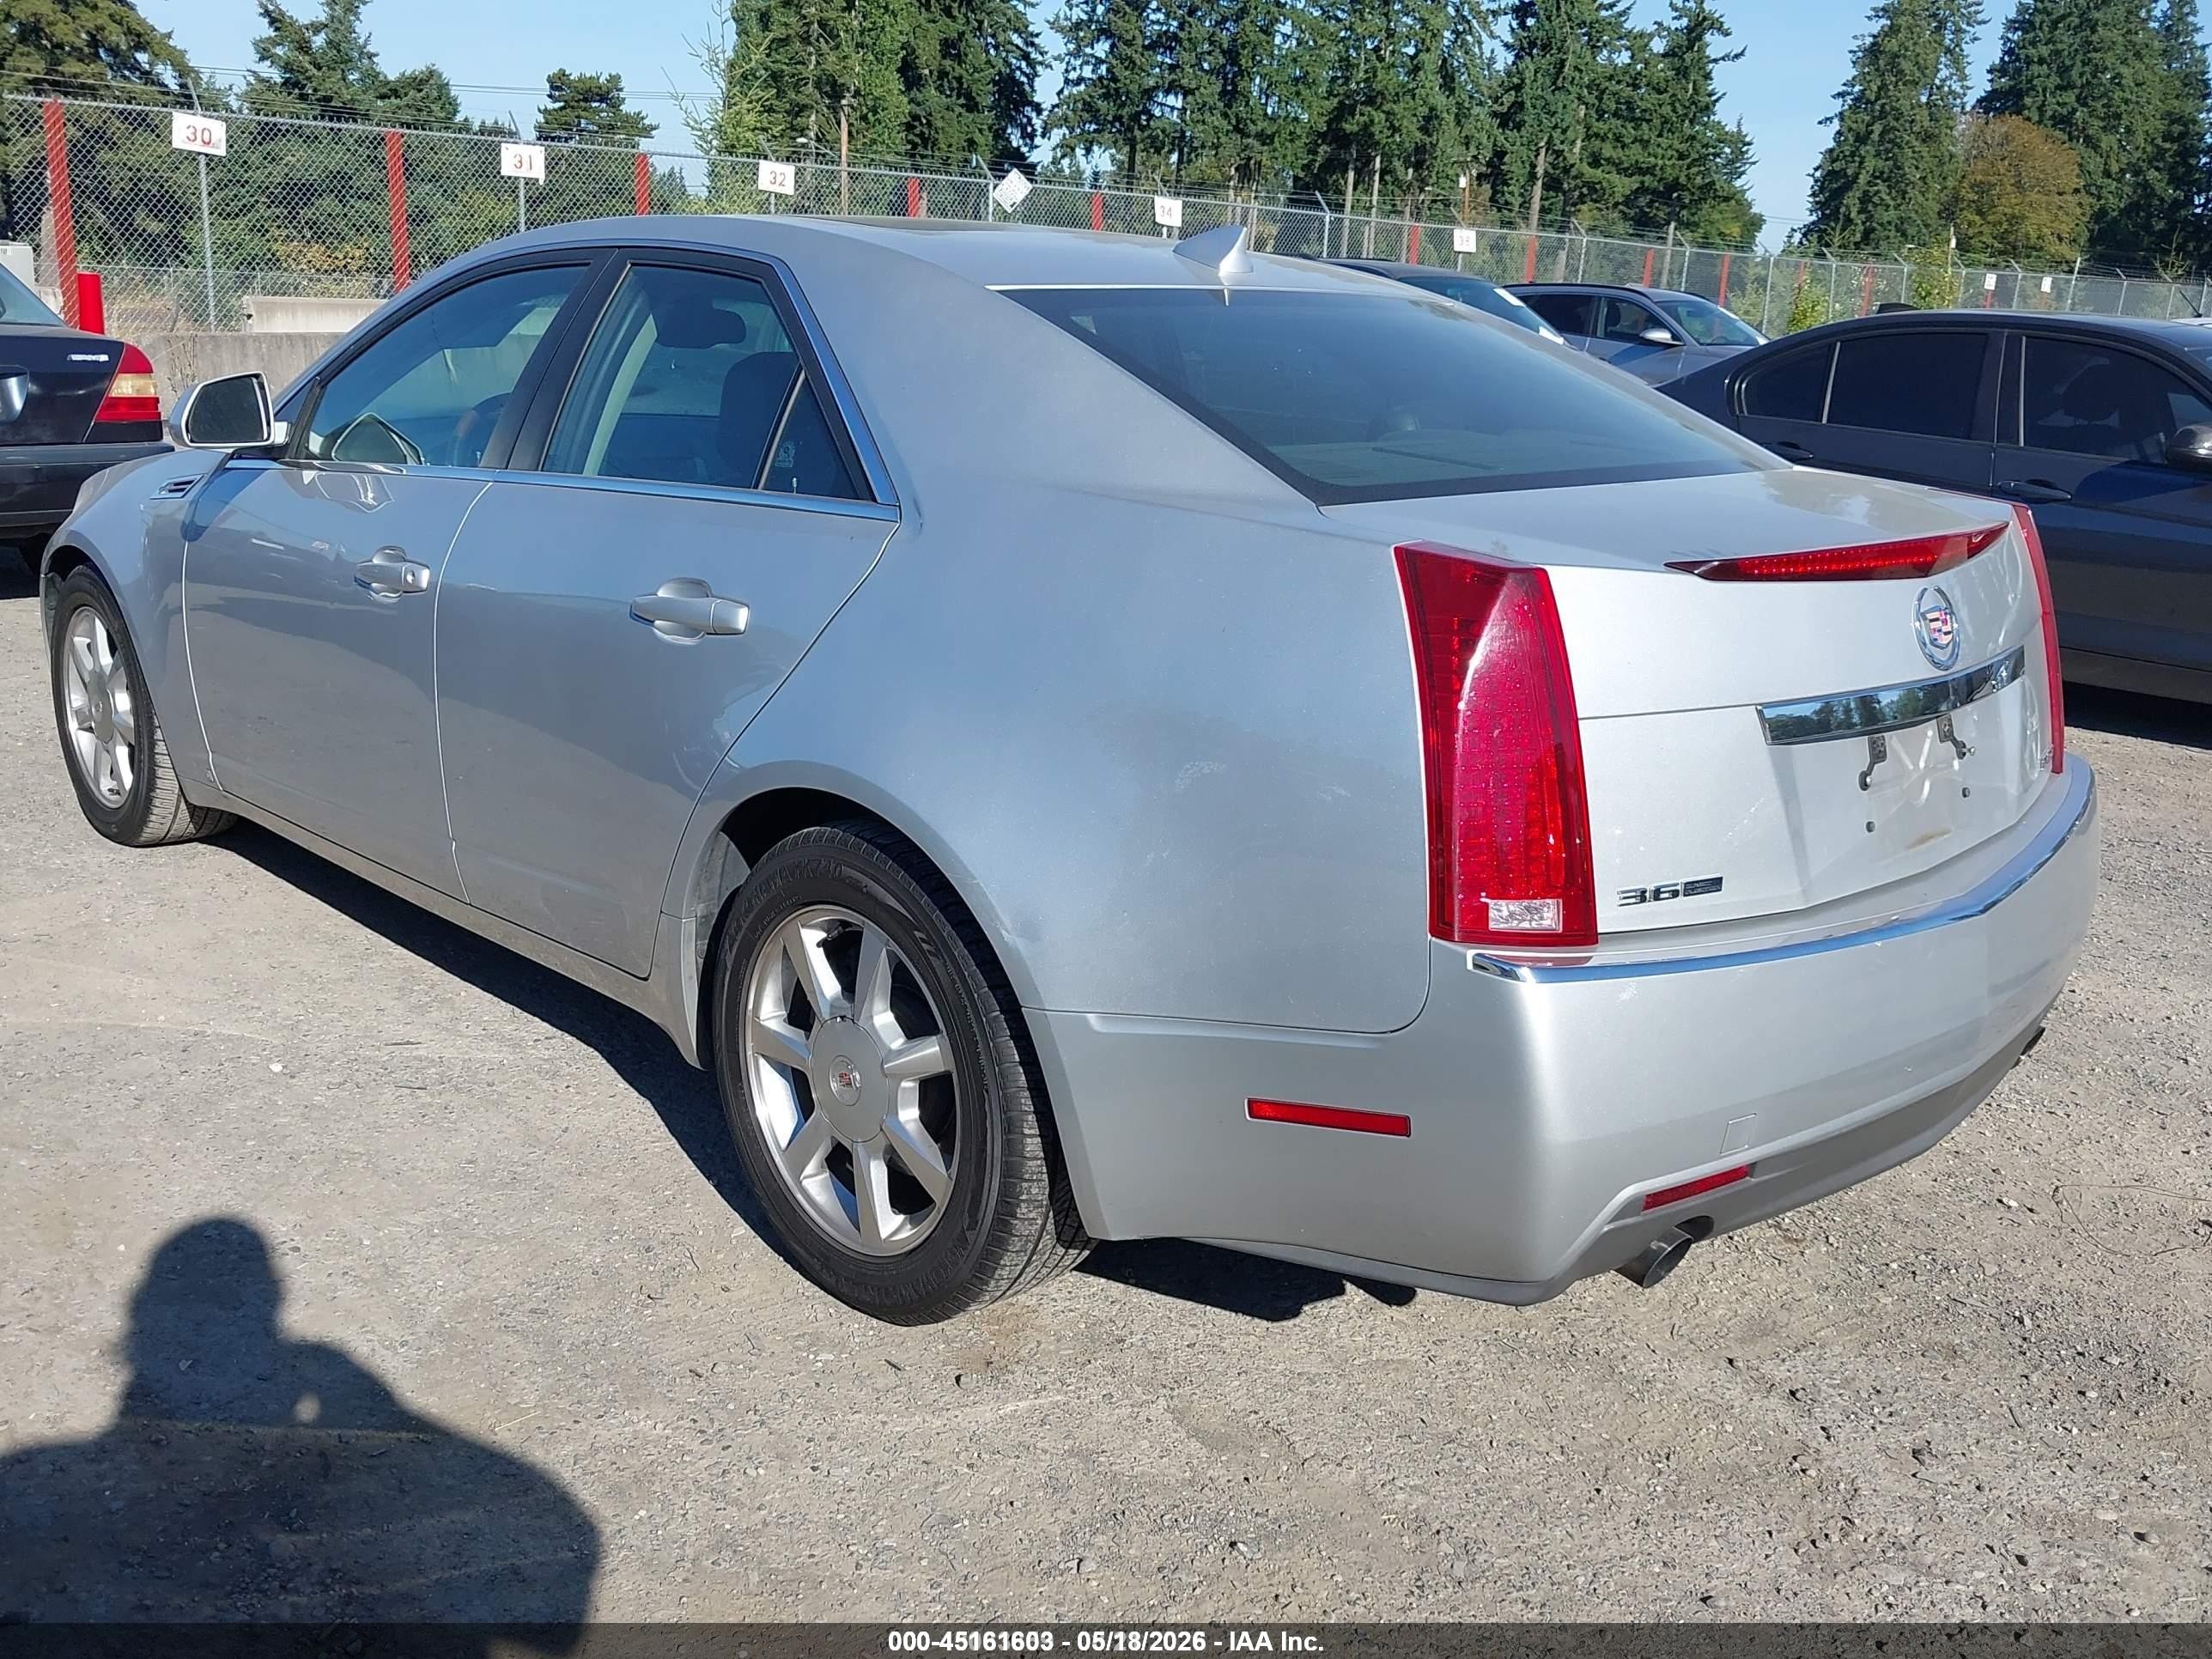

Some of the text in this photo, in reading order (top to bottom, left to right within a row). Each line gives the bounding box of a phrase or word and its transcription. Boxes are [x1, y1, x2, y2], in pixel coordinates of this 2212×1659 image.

[186, 125, 212, 145] 30
[514, 153, 532, 171] 31
[769, 170, 787, 187] 32
[1159, 205, 1172, 220] 34
